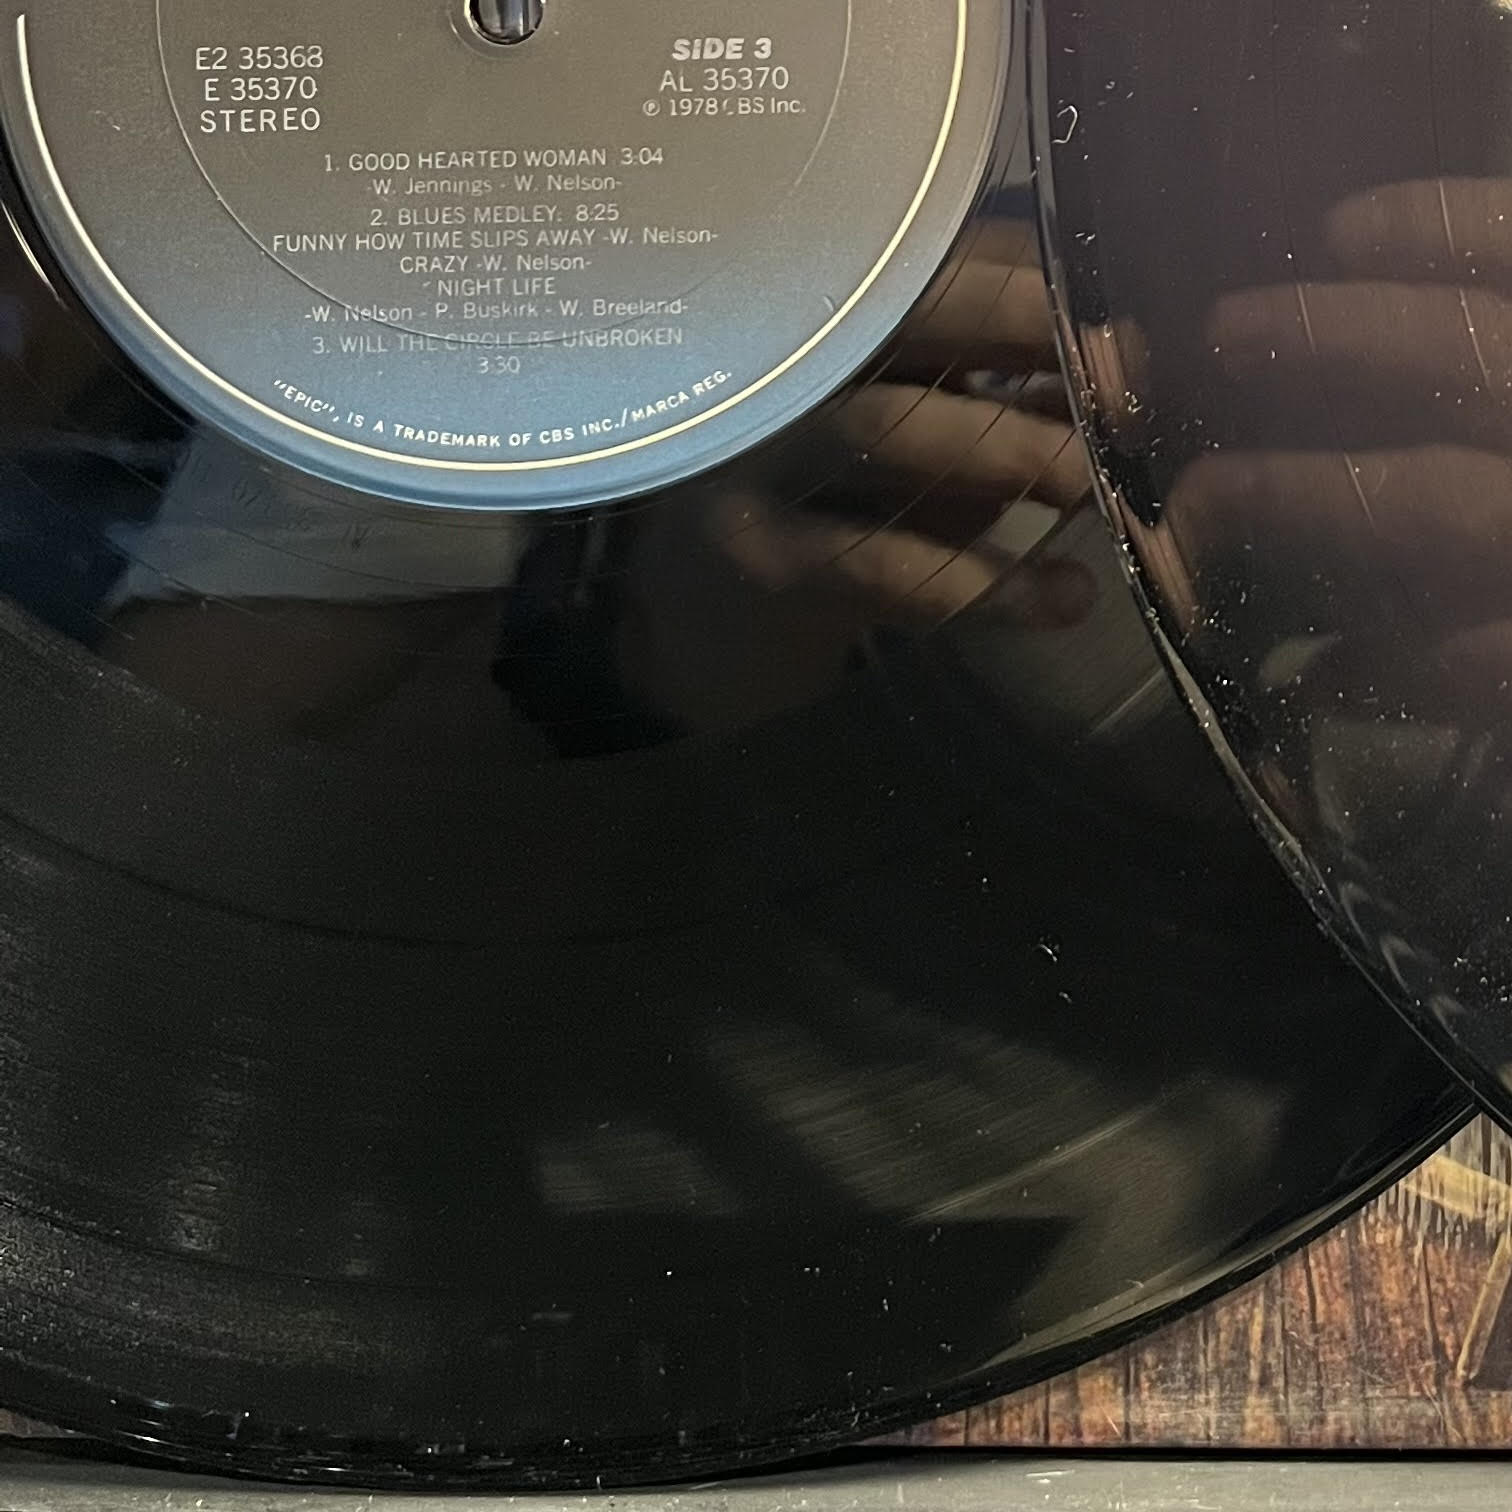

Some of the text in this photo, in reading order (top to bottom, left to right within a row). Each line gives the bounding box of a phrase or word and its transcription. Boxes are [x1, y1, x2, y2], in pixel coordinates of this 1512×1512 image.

[195, 45, 324, 70] E2 35368
[672, 37, 772, 61] SIDE 3
[204, 76, 318, 101] E 35370
[659, 66, 789, 93] AL 35370
[669, 97, 719, 116] 1978
[771, 97, 807, 114] Inc.
[200, 107, 321, 133] STEREO
[324, 147, 664, 172] 1. GOOD HEARTED WOMAN 3:04
[405, 177, 493, 196] Jennings
[370, 208, 388, 226] 2.
[398, 206, 466, 226] BLUES
[575, 203, 620, 221] 8:25
[273, 234, 348, 252] FUNNY
[355, 233, 405, 250] HOW
[412, 231, 464, 249] TIME
[470, 229, 529, 248] SLIPS
[536, 228, 596, 246] AWAY
[400, 255, 468, 274] CRAZY
[437, 276, 556, 296] NIGHT LIFE
[344, 304, 413, 322] Nelson
[463, 301, 539, 319] Buskirk
[312, 336, 330, 354] 3.
[340, 335, 388, 354] WILL
[397, 333, 439, 352] THE
[562, 328, 683, 349] UNBROKEN
[346, 411, 365, 428] IS
[373, 420, 384, 433] A
[393, 423, 501, 447] TRADEMARK
[508, 433, 533, 447] OF
[539, 427, 575, 444] CBS
[691, 369, 733, 397] REG.
